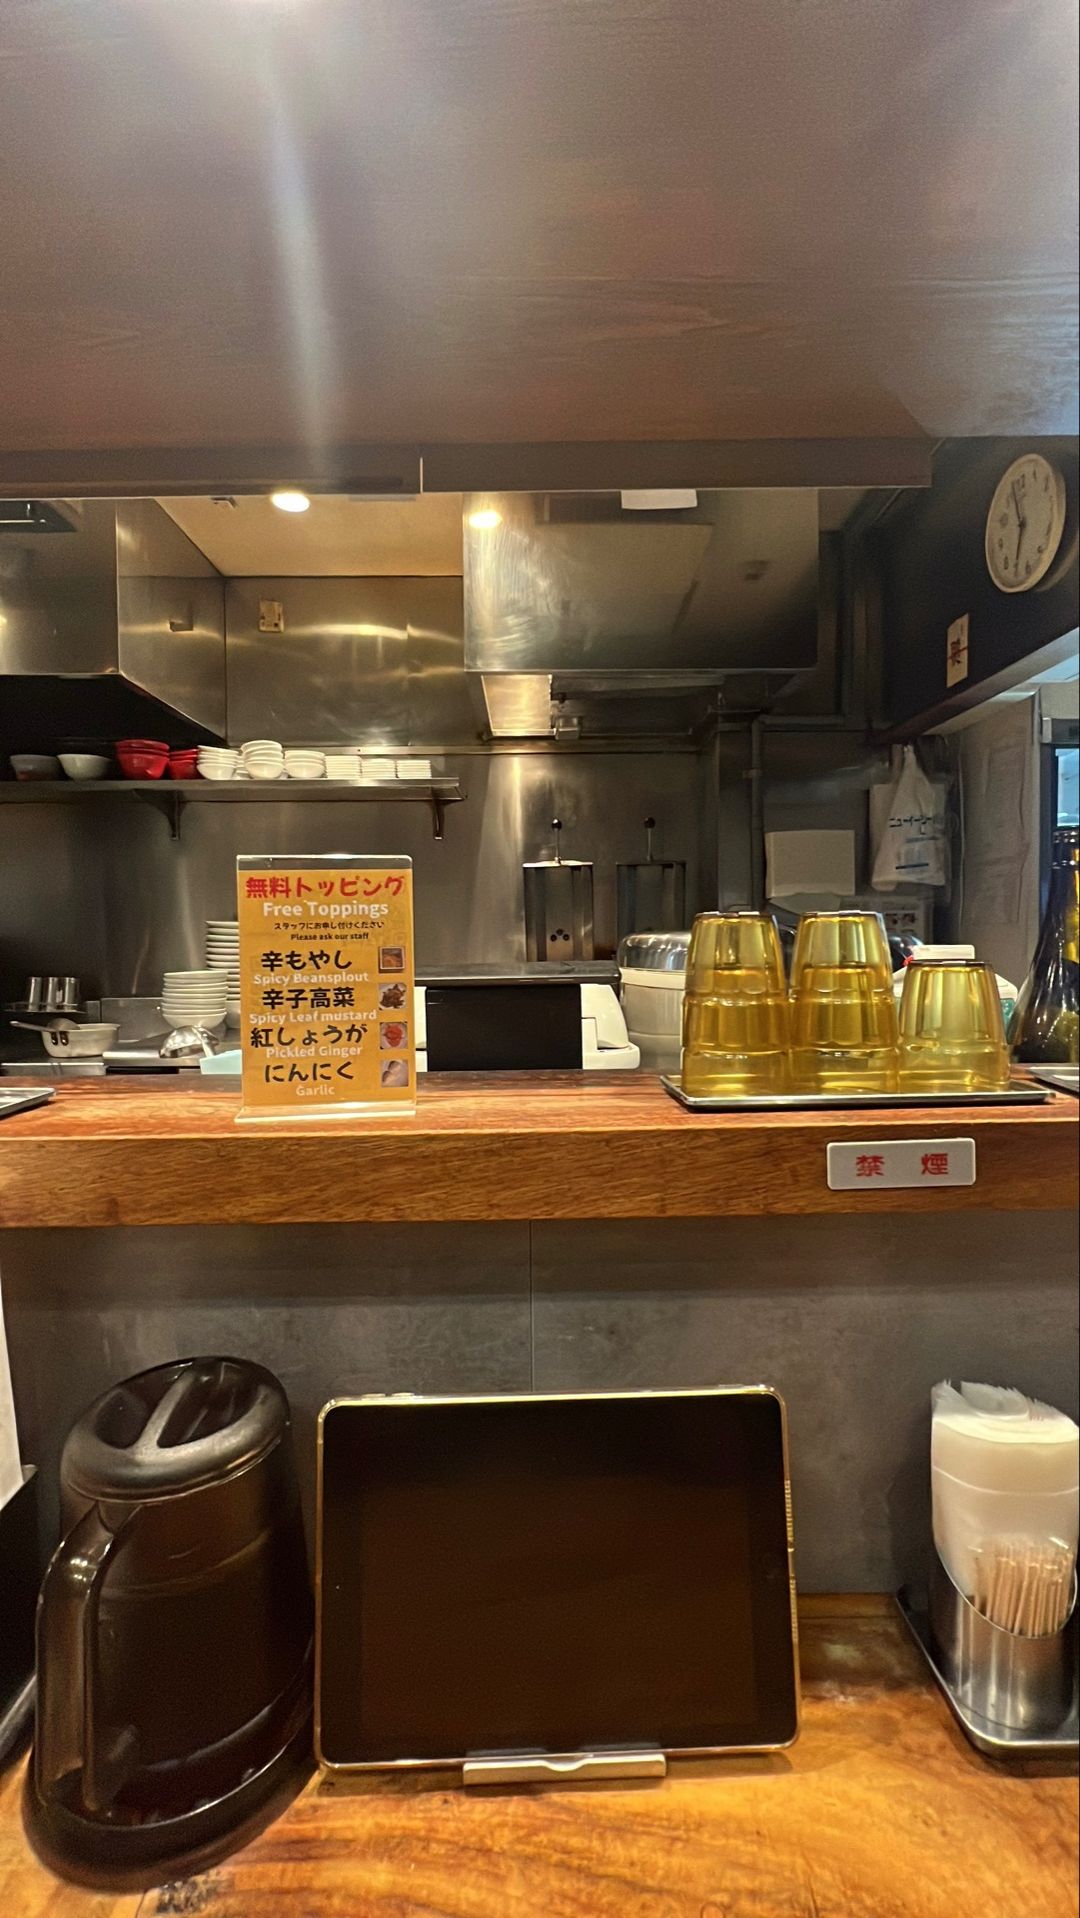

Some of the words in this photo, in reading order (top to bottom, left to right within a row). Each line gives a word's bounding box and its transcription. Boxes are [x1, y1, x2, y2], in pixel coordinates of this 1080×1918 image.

[246, 876, 405, 899] 無料トッピング
[263, 902, 303, 917] Free
[307, 901, 389, 919] Toppings
[274, 921, 385, 930] スタッフにお申し付けください
[291, 933, 317, 941] Please
[350, 932, 369, 940] staff
[261, 950, 353, 972] 辛もやし
[253, 973, 290, 987] Spicy
[293, 972, 369, 986] Beansplout
[262, 987, 355, 1010] 辛子高菜
[249, 1013, 287, 1025] Spicy
[289, 1011, 319, 1023] Leaf
[320, 1009, 378, 1022] mustard
[250, 1023, 369, 1049] 紅しょうが
[266, 1047, 315, 1059] Pickled
[319, 1045, 363, 1058] Ginger
[265, 1061, 355, 1083] にんにく
[295, 1085, 336, 1097] Garlic
